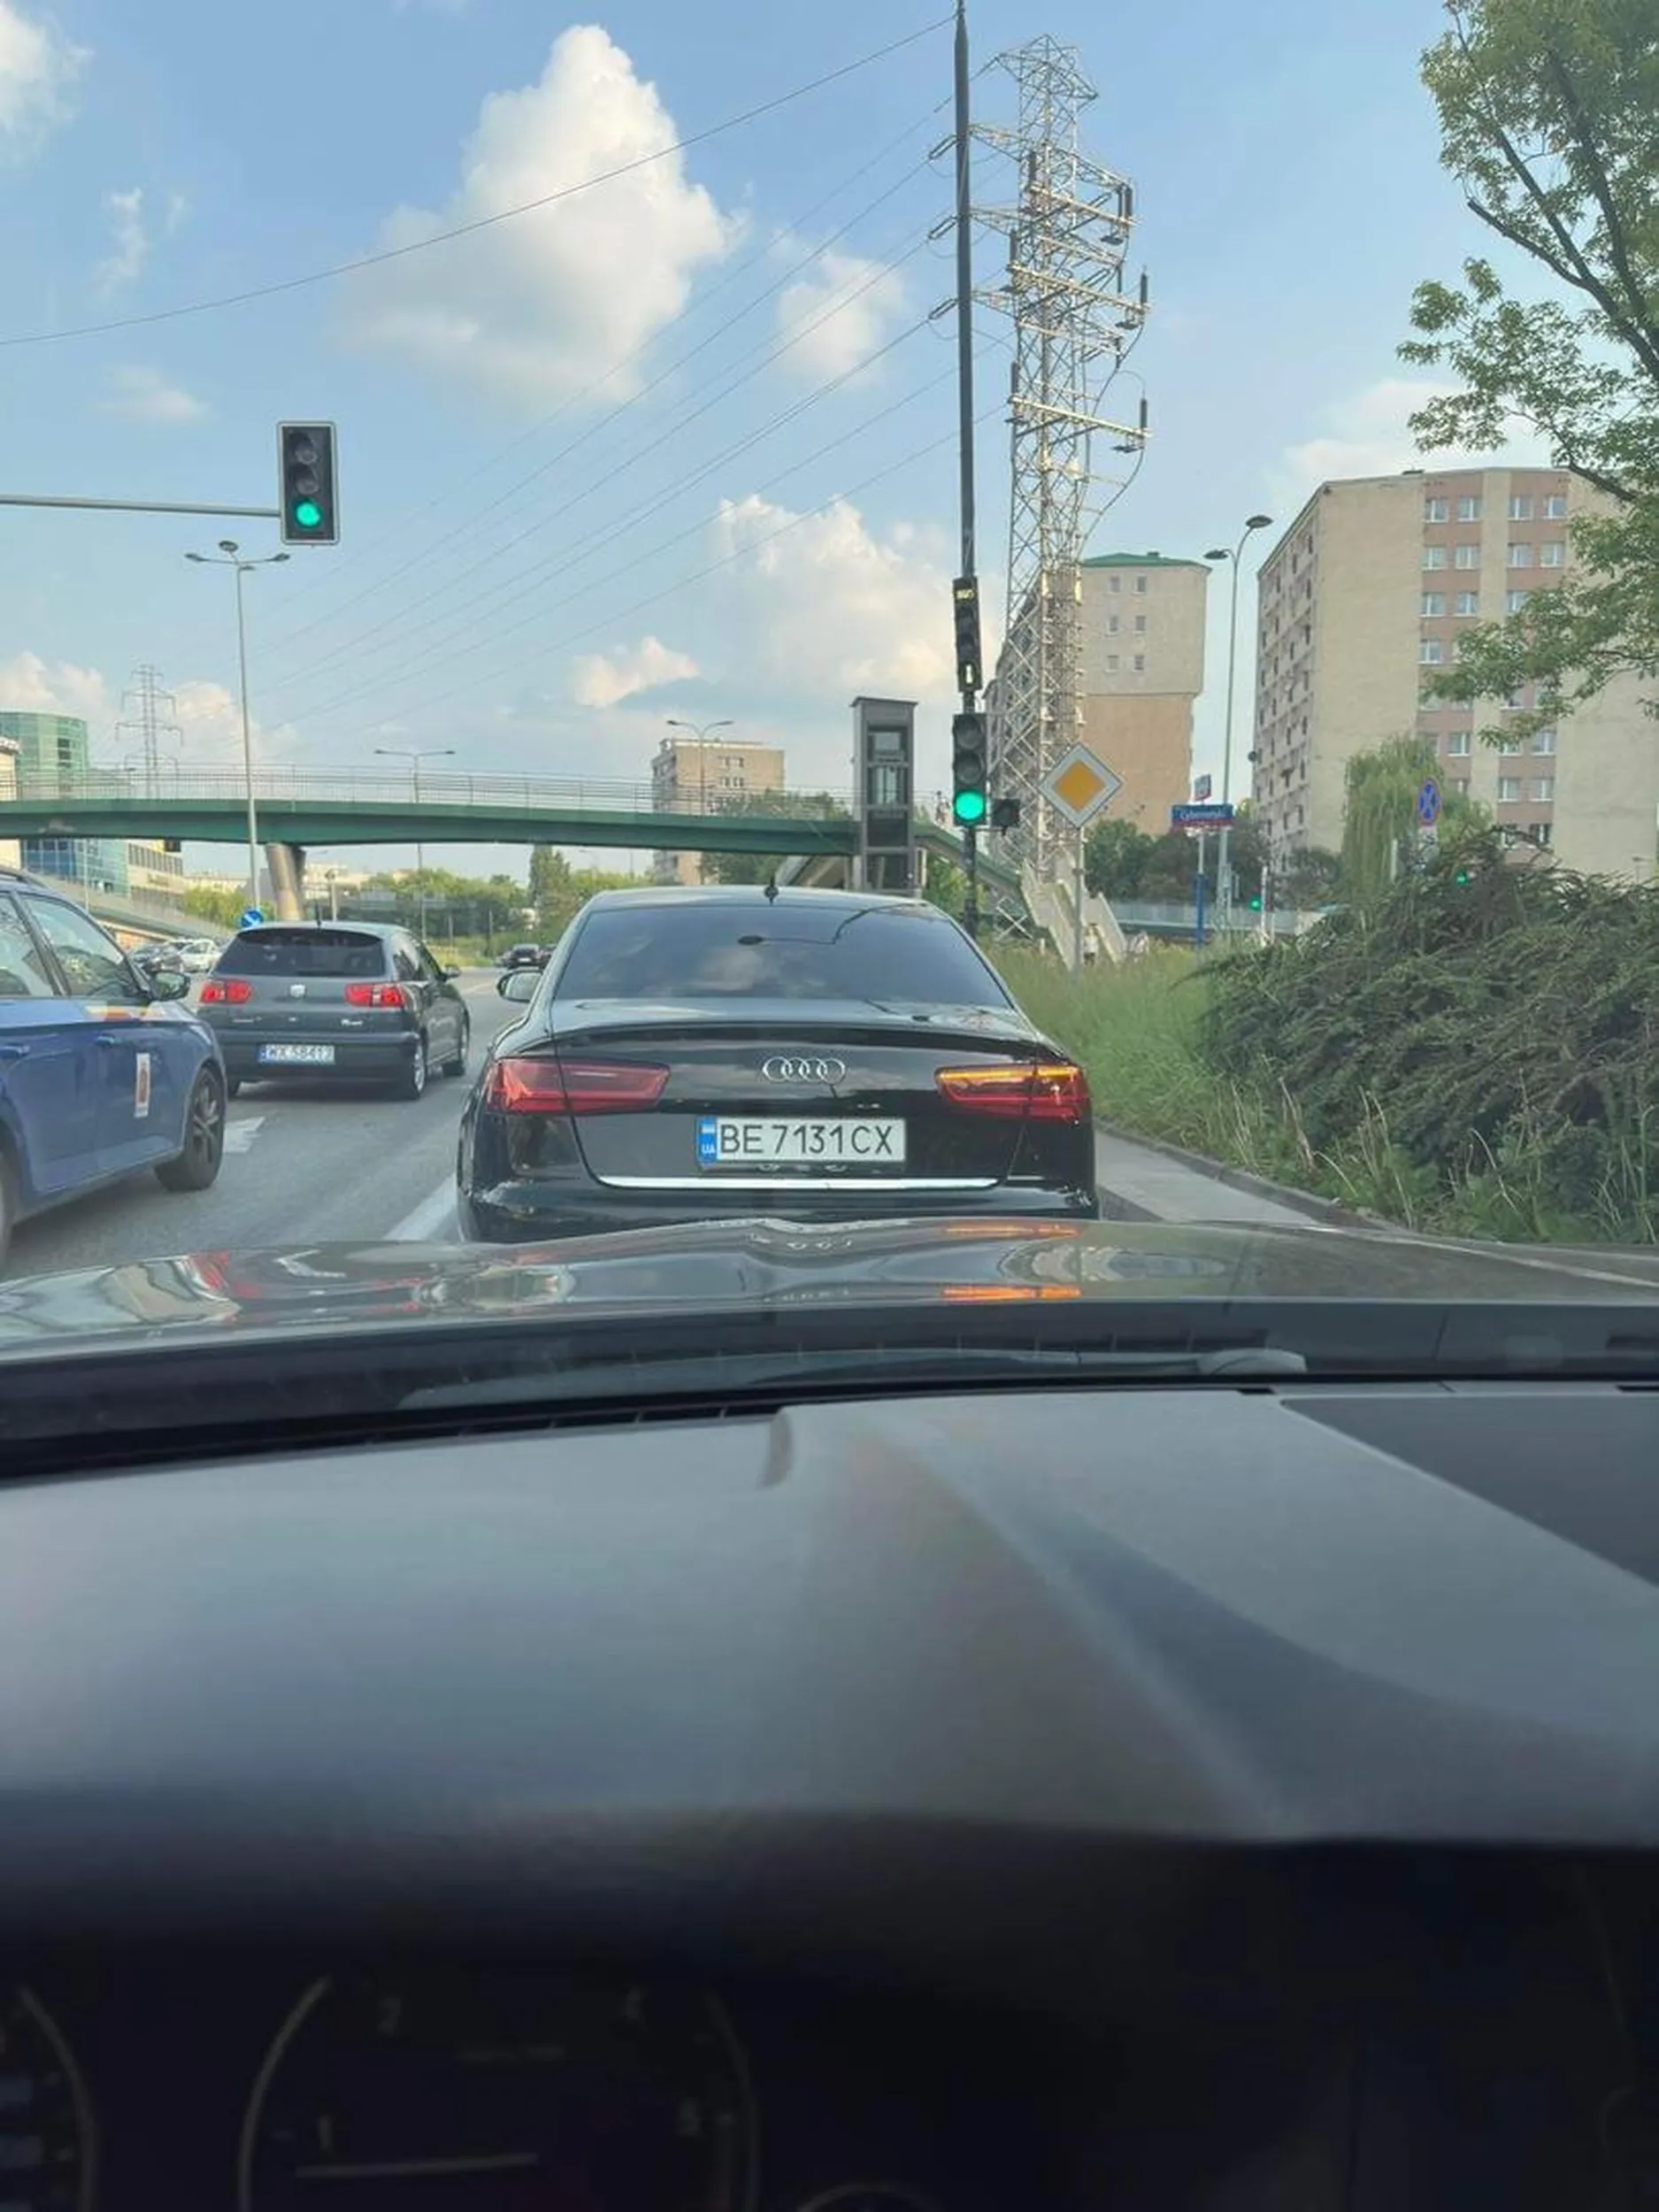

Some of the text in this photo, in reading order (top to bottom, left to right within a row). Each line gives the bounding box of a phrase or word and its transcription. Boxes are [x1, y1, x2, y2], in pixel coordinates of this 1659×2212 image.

[701, 1143, 716, 1154] UA
[720, 1125, 892, 1154] BE 7131 CX
